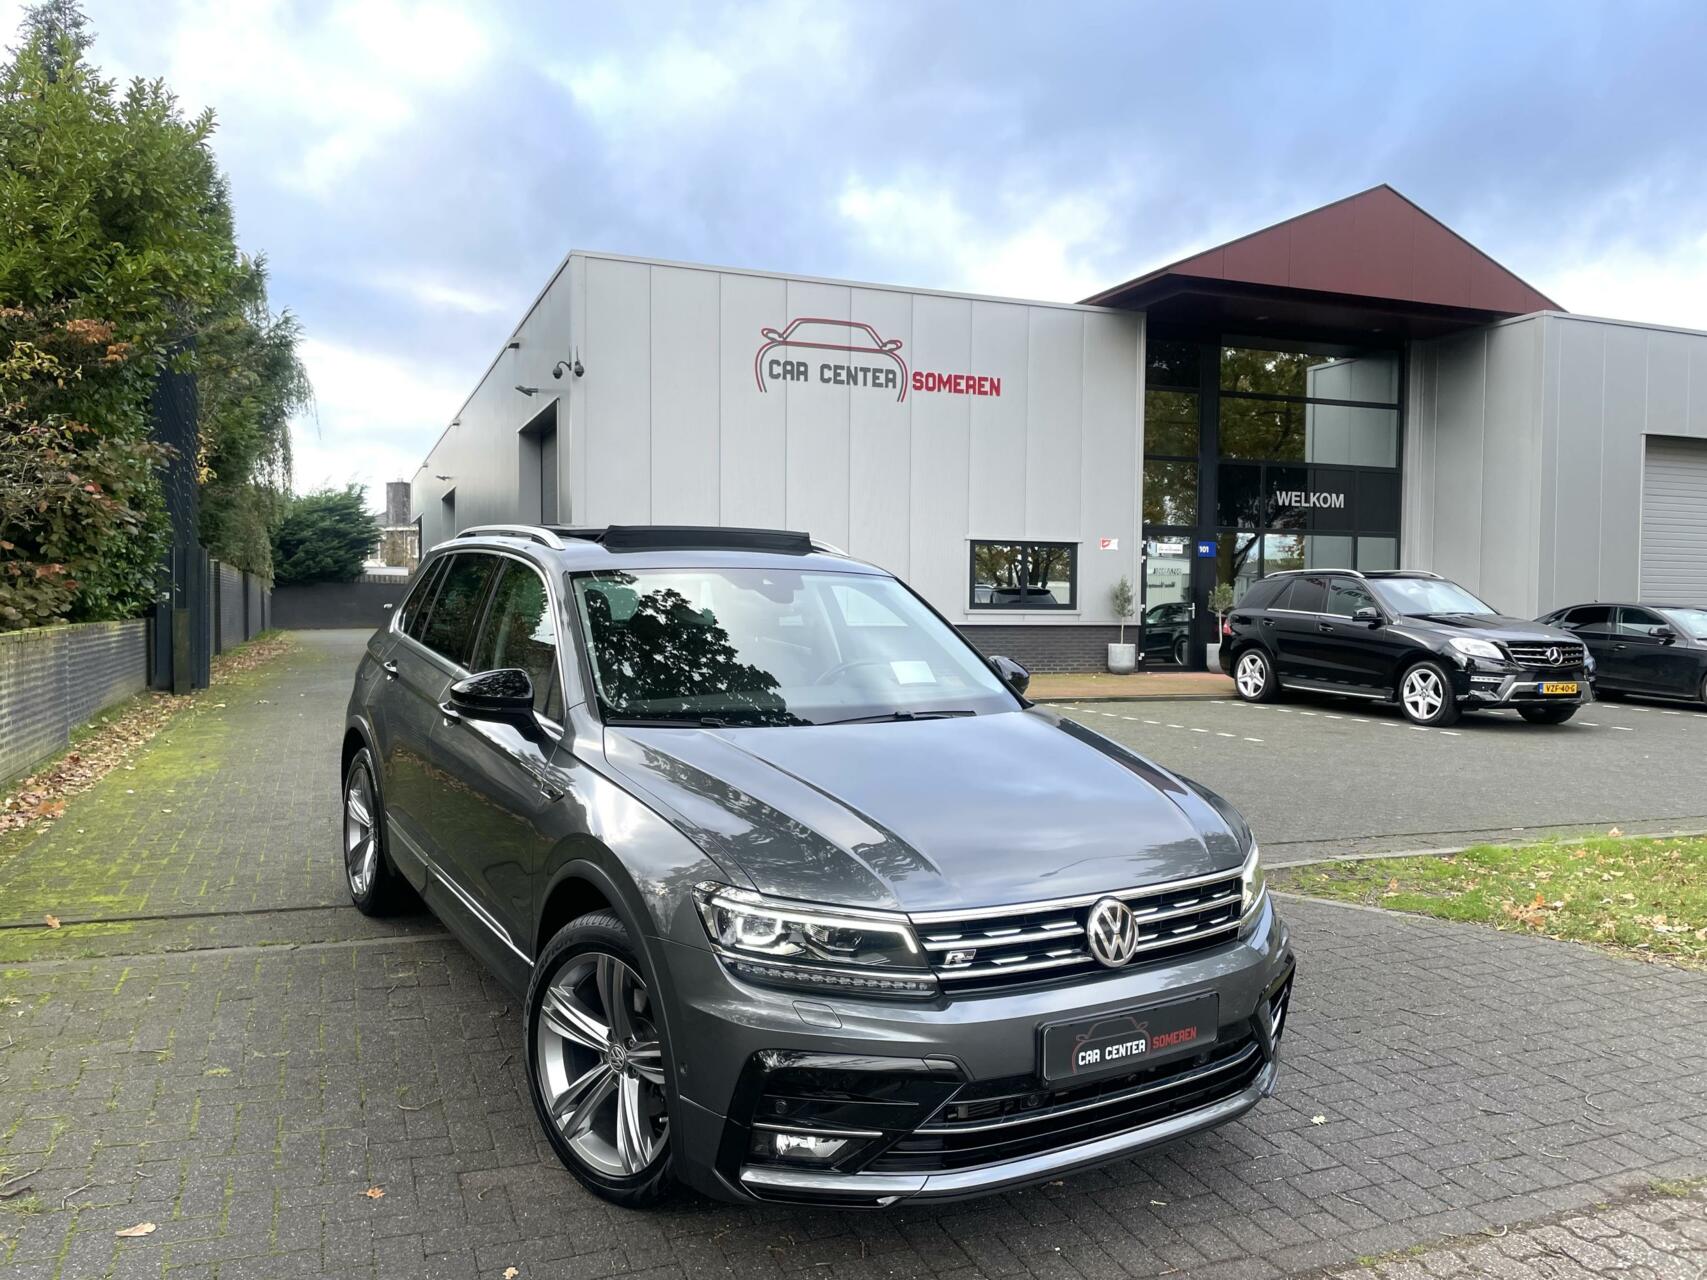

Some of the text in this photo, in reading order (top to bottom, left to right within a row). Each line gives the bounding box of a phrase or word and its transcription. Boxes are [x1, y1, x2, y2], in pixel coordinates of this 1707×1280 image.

[768, 359, 1001, 397] CAR CENTER SOMEREN
[1276, 490, 1345, 509] WELKOM
[1078, 1026, 1198, 1066] CAR CENTER SOMEREN
